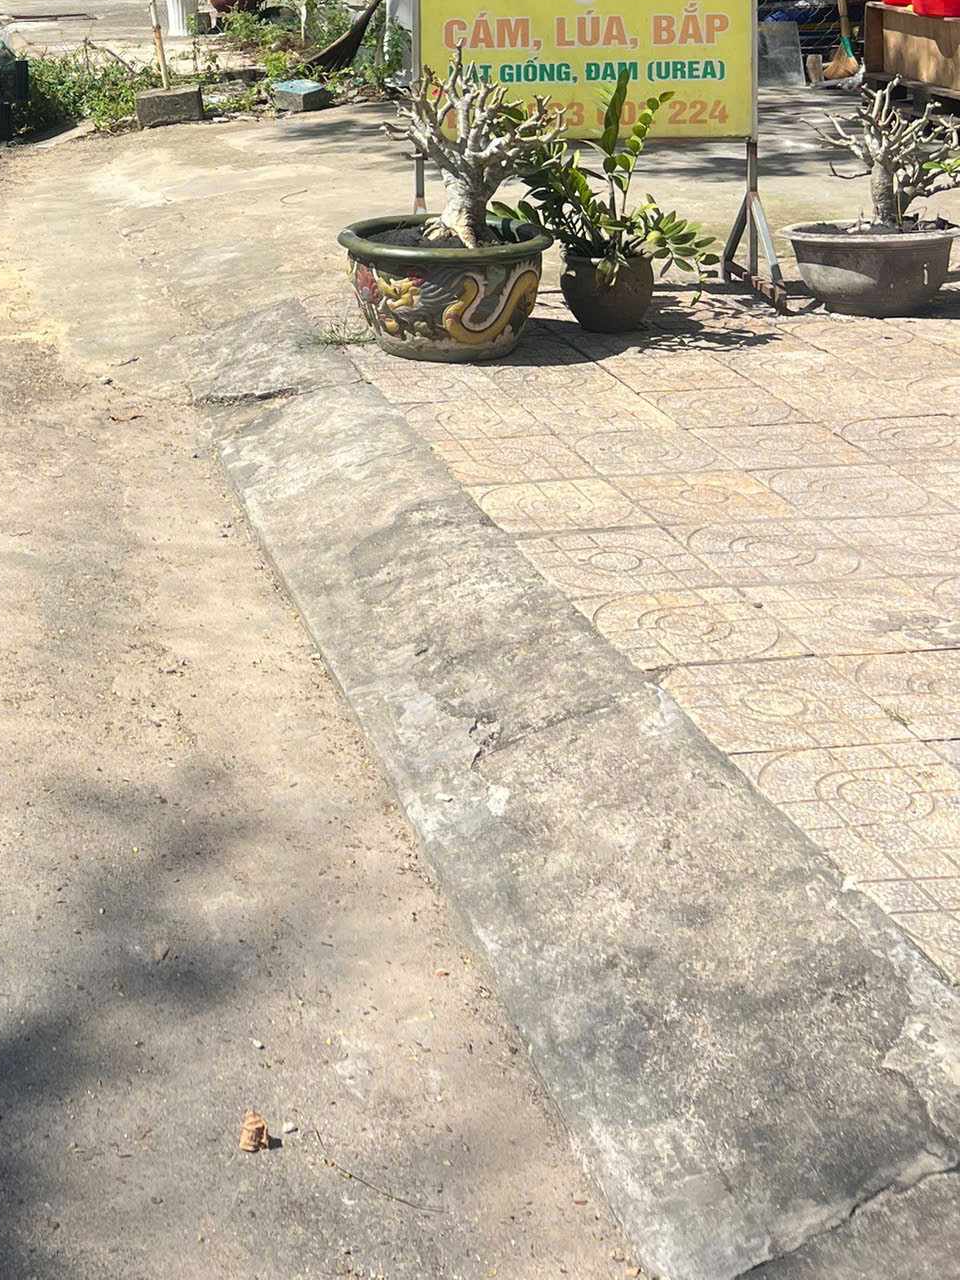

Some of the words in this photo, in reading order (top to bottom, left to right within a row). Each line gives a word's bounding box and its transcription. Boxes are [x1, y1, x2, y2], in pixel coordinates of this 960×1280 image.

[443, 12, 542, 52] CÁM,
[555, 9, 639, 51] LÚA,
[652, 3, 729, 46] BẮP
[499, 56, 578, 83] GIỐNG,
[647, 60, 726, 82] (UREA)
[667, 99, 729, 125] 224
